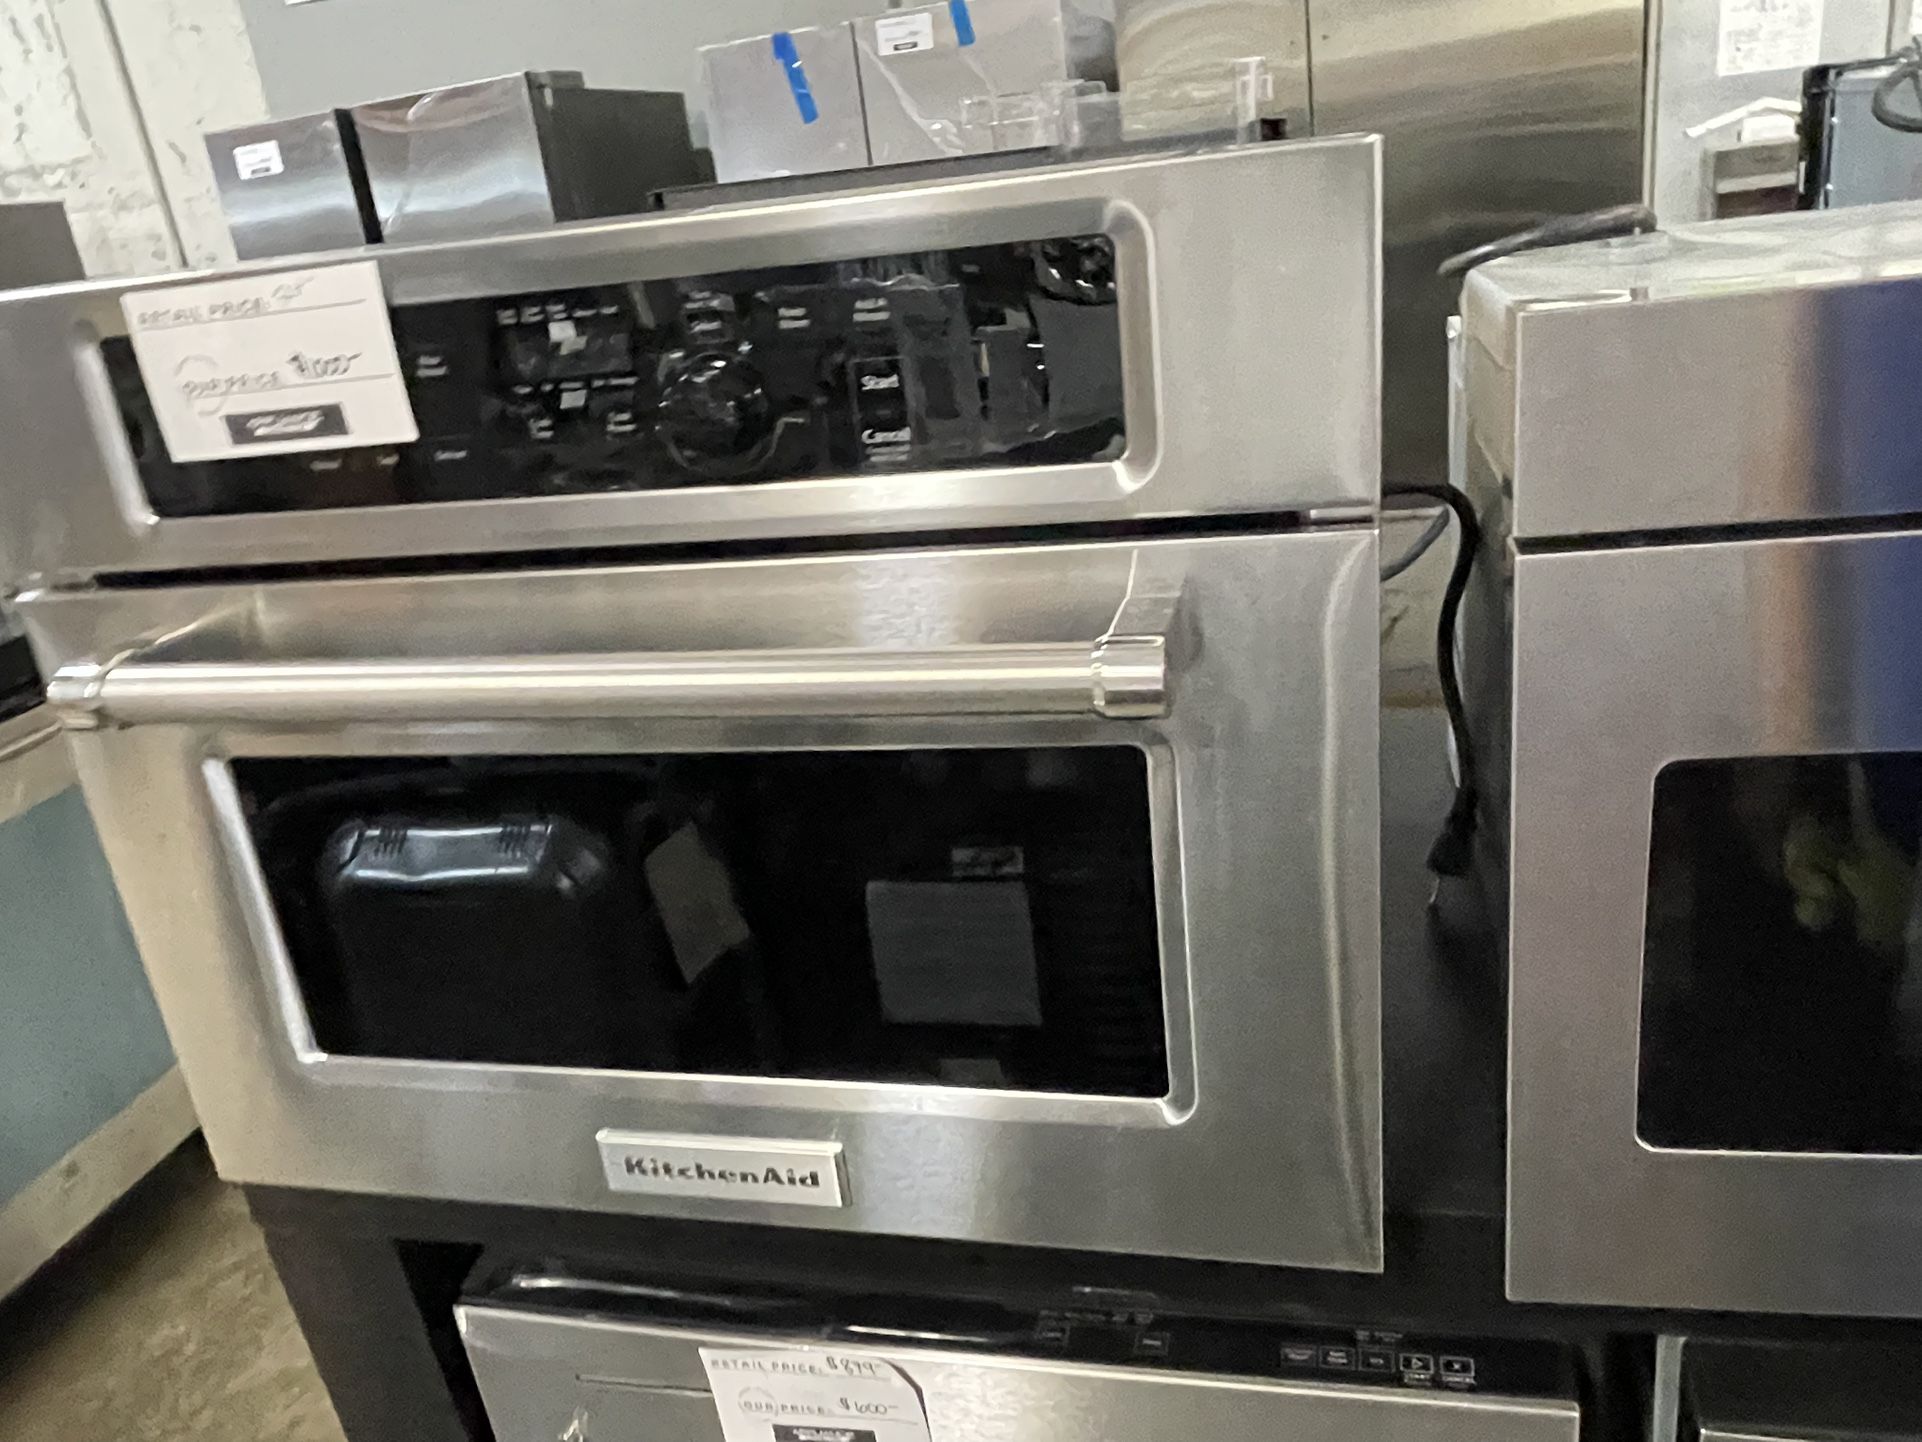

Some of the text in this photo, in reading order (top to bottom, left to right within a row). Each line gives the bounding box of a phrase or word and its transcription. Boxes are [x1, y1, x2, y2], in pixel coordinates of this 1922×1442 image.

[623, 1155, 822, 1187] KitchenAid
[710, 1358, 766, 1373] RETAIL
[743, 1400, 775, 1414] OUR
